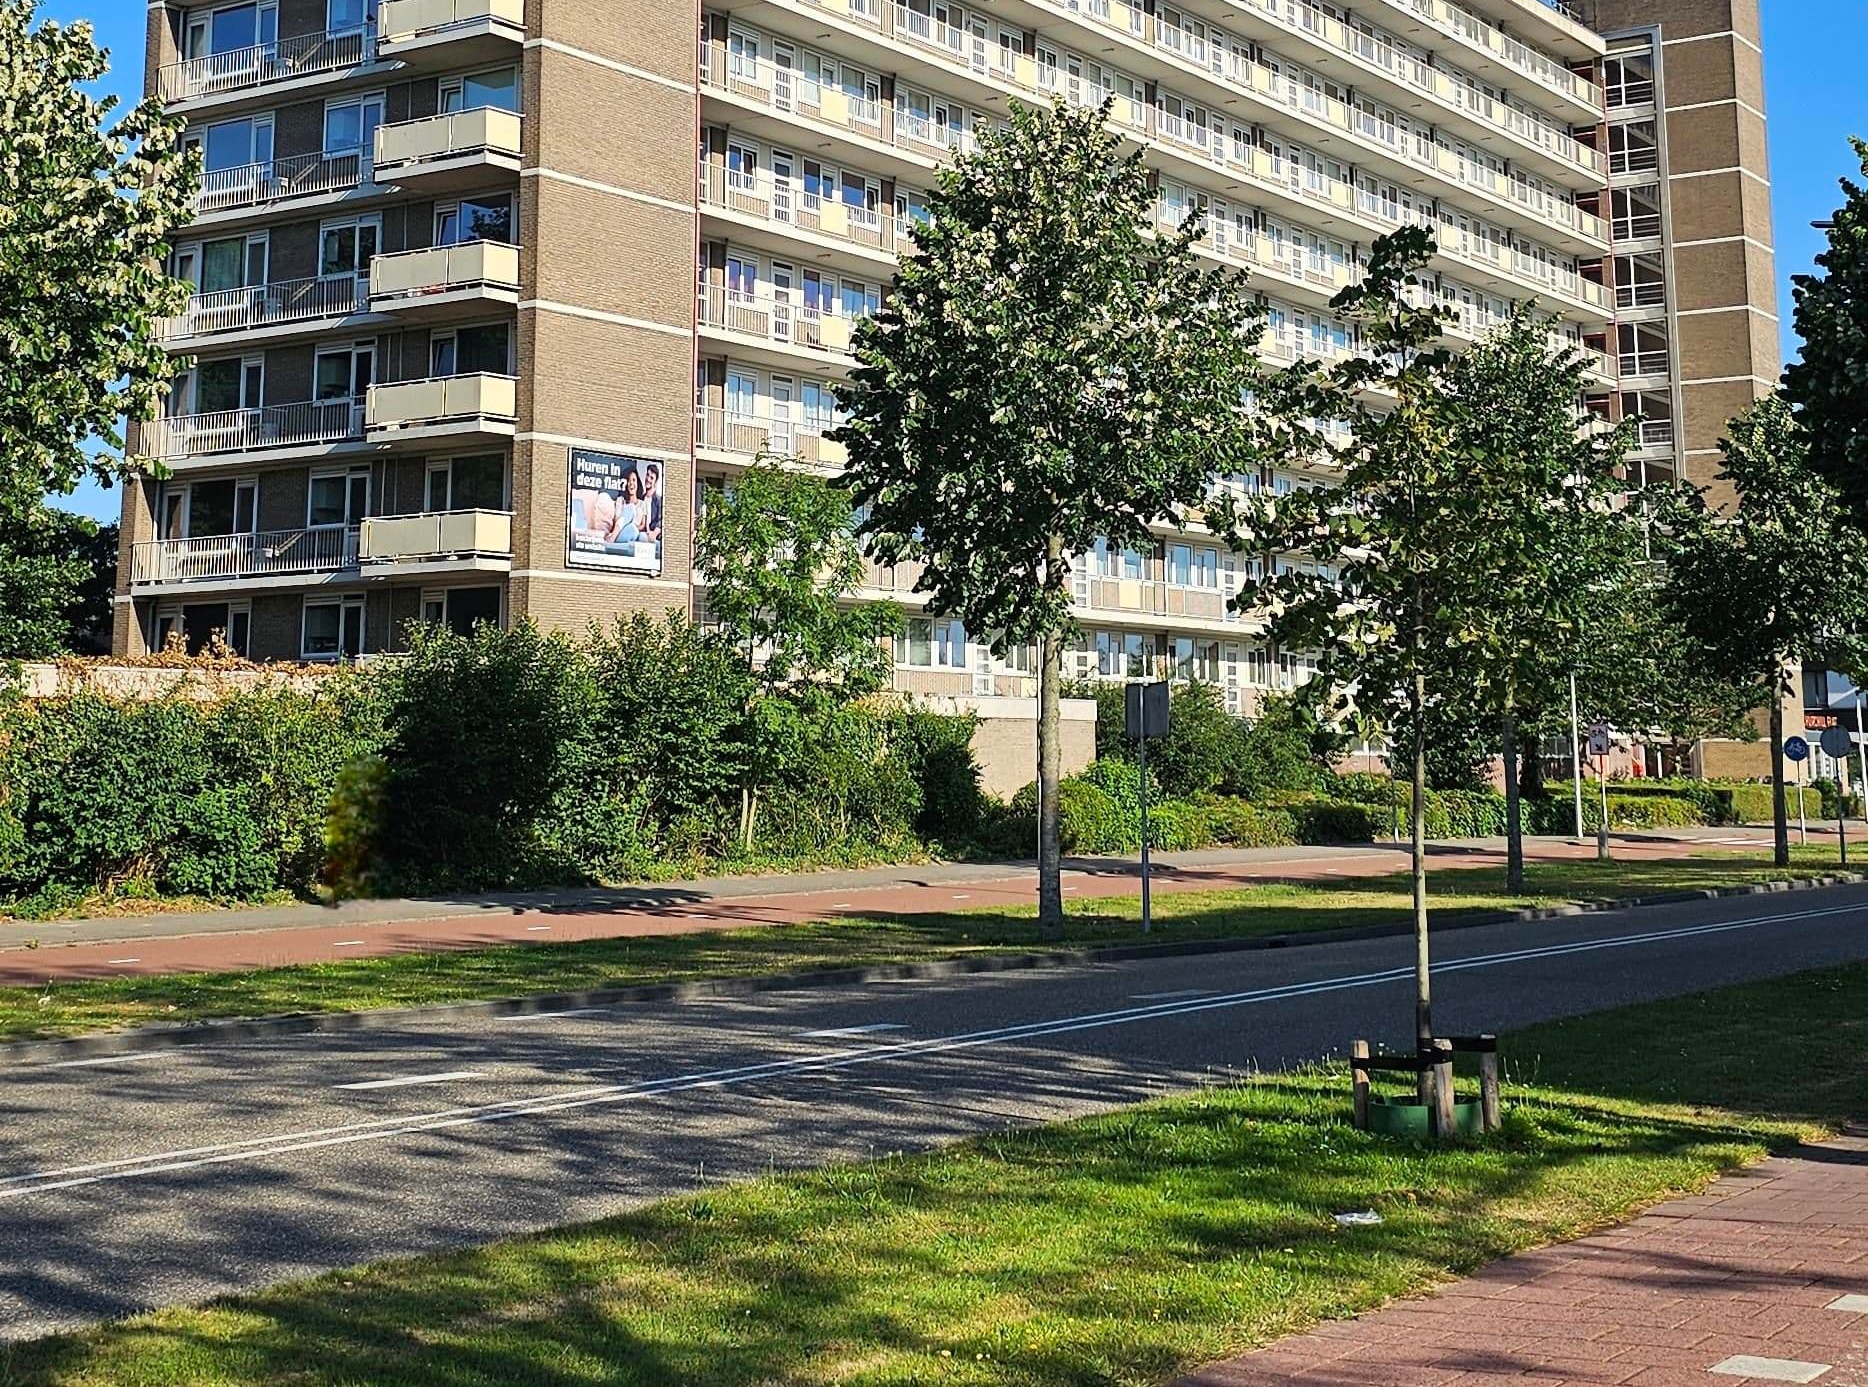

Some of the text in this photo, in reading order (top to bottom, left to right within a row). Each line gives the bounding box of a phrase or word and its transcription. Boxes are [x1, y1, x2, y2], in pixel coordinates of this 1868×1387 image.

[576, 457, 609, 475] Huren
[576, 473, 628, 491] deze flat?
